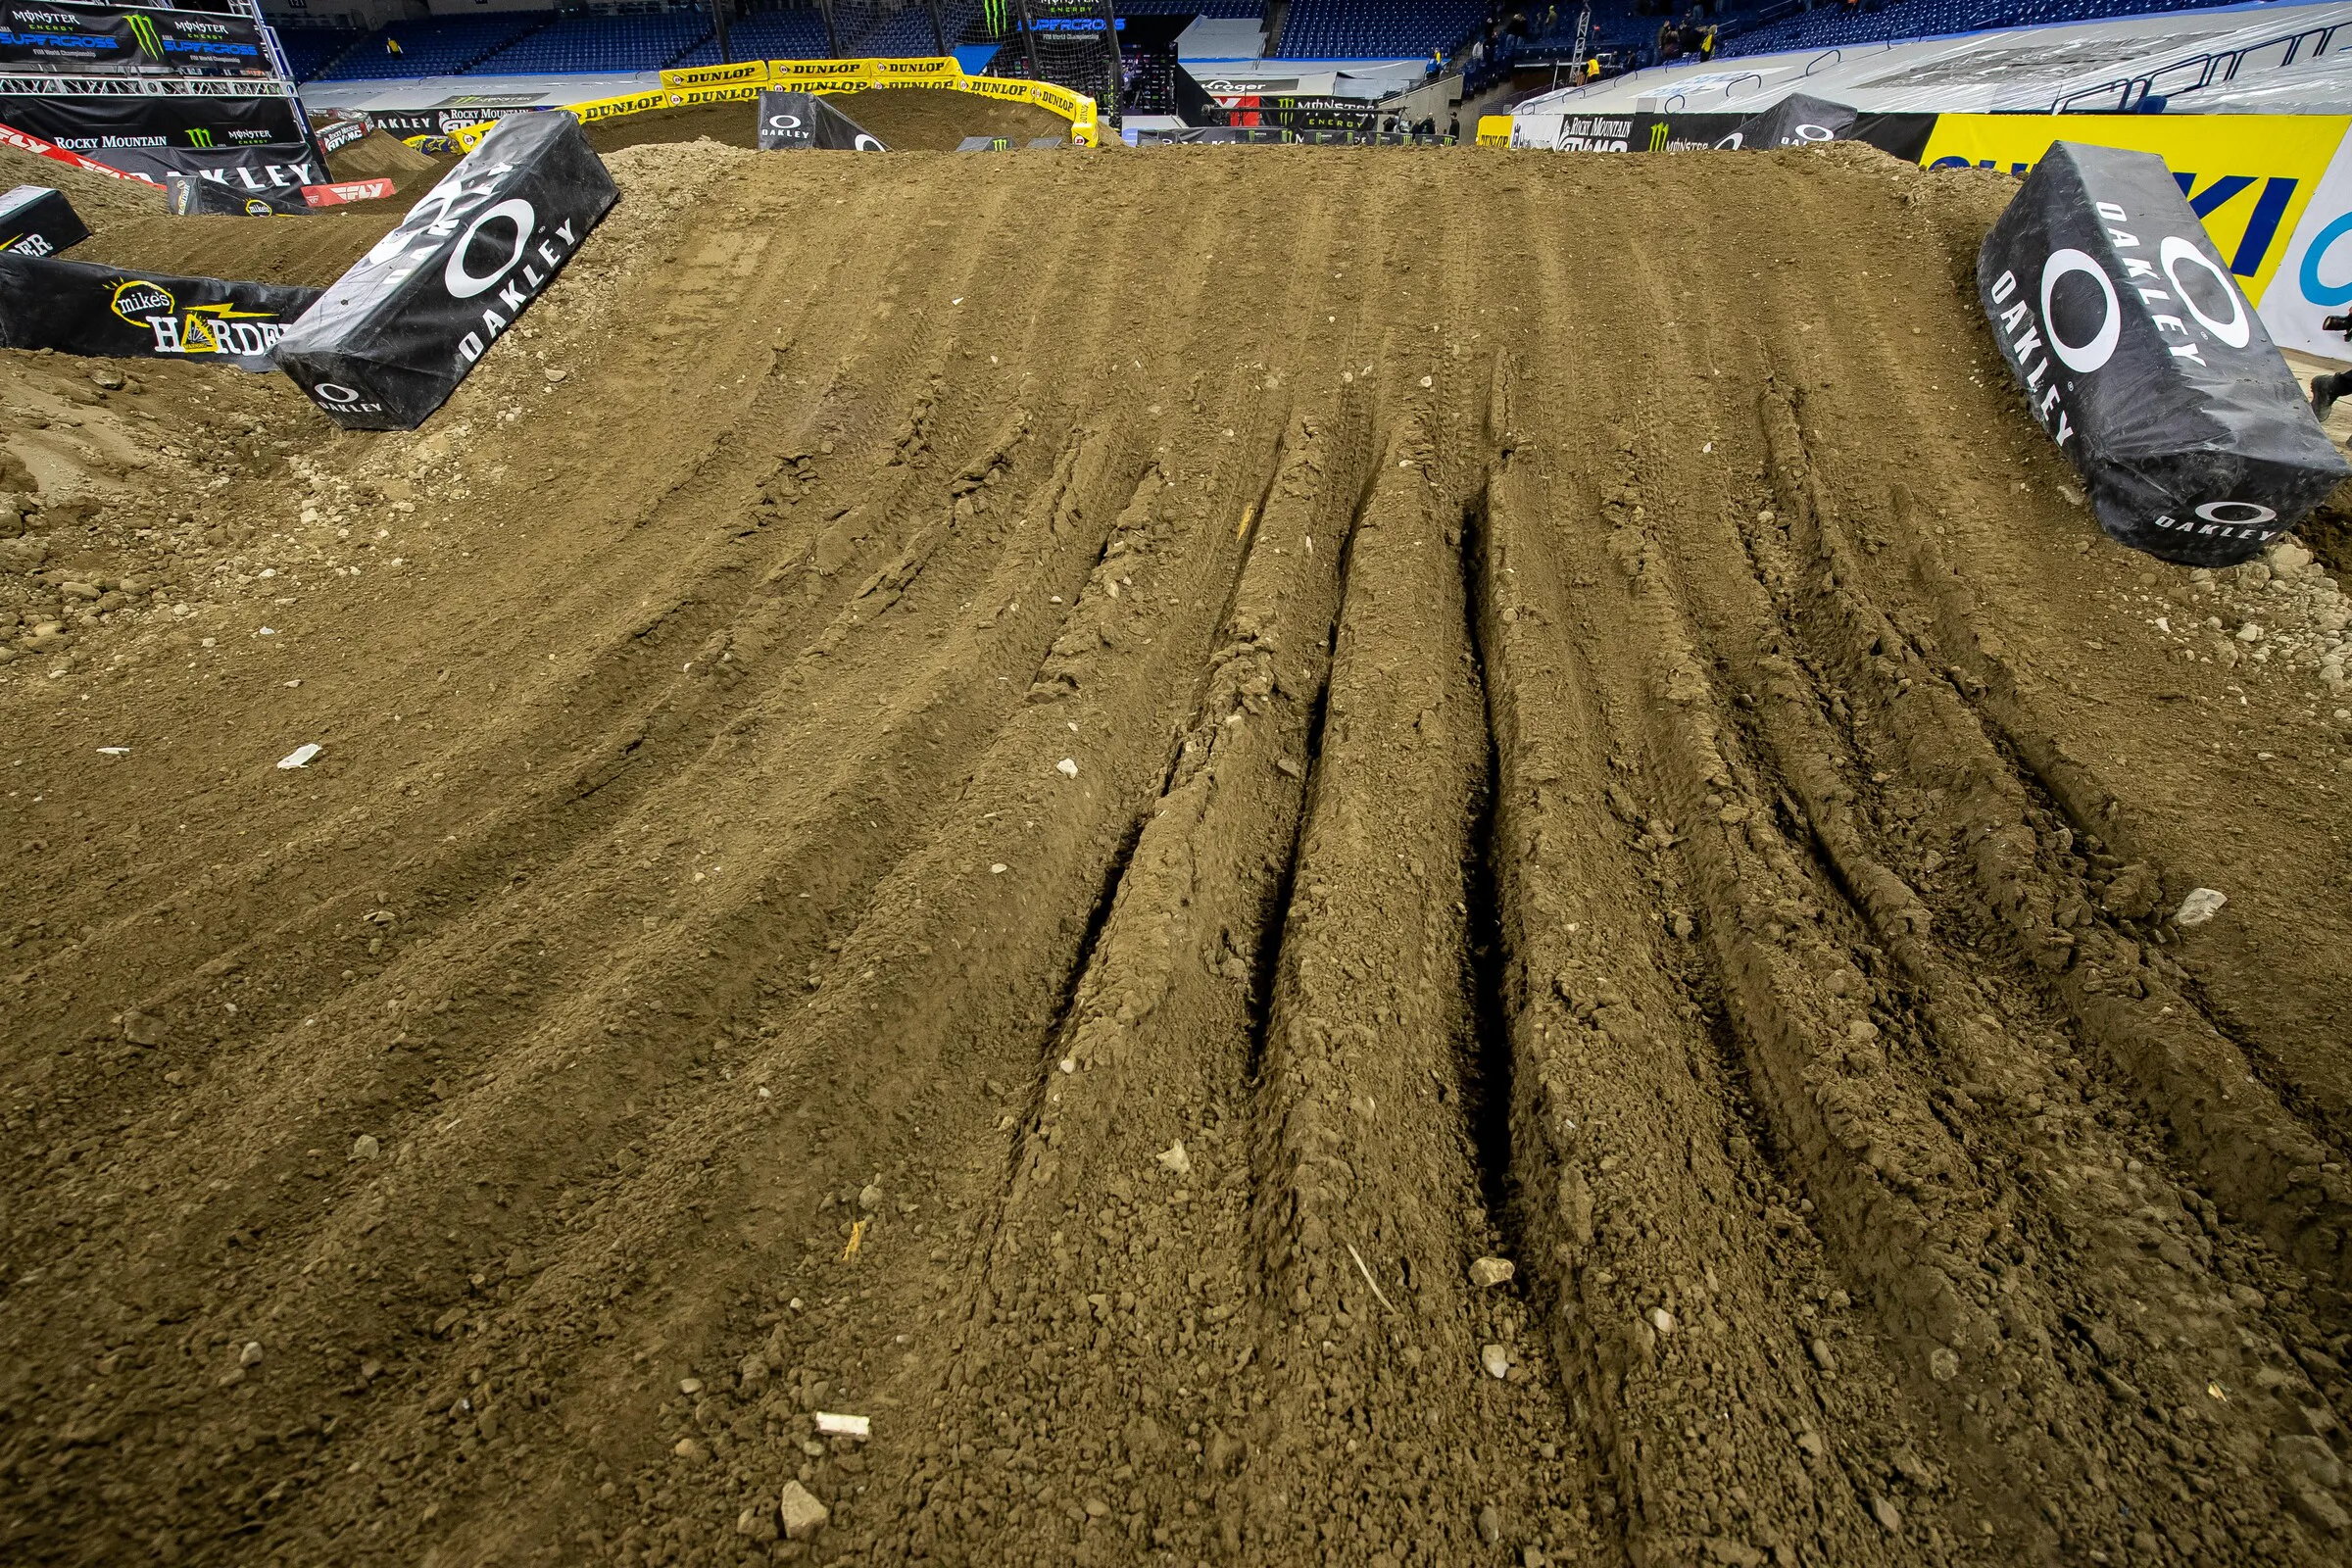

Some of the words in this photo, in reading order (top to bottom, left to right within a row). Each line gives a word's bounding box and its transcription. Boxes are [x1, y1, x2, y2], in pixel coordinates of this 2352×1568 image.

[12, 10, 80, 24] MONSTER
[174, 21, 228, 34] MONSTER
[163, 40, 258, 56] SUPERCROSS
[793, 65, 859, 74] DUNLOP
[890, 63, 945, 73] DUNLOP
[687, 68, 755, 83] DUNLOP
[790, 81, 867, 93] DUNLOP
[971, 81, 1027, 95] DUNLOP
[585, 95, 662, 120] DUNLOP
[1042, 92, 1074, 113] DUNLOP
[1298, 100, 1375, 119] MONSTER
[451, 110, 478, 120] ROCKY
[377, 118, 431, 129] AKLEY
[1309, 119, 1362, 129] ENERGY
[1570, 117, 1592, 135] ROCKY
[1590, 117, 1632, 138] MOUNTAIN
[228, 129, 271, 139] MONSTER
[761, 128, 809, 139] OAKLEY
[54, 137, 98, 149] ROCKY
[101, 135, 168, 148] MOUNTAIN
[333, 183, 383, 202] FLY
[458, 218, 575, 363] OAKLEY
[2095, 201, 2207, 368] OAKLEY
[117, 292, 171, 315] mike's
[1990, 270, 2074, 448] OAKLEY
[318, 402, 382, 413] OAKLEY
[2156, 514, 2278, 542] OAKLEY
